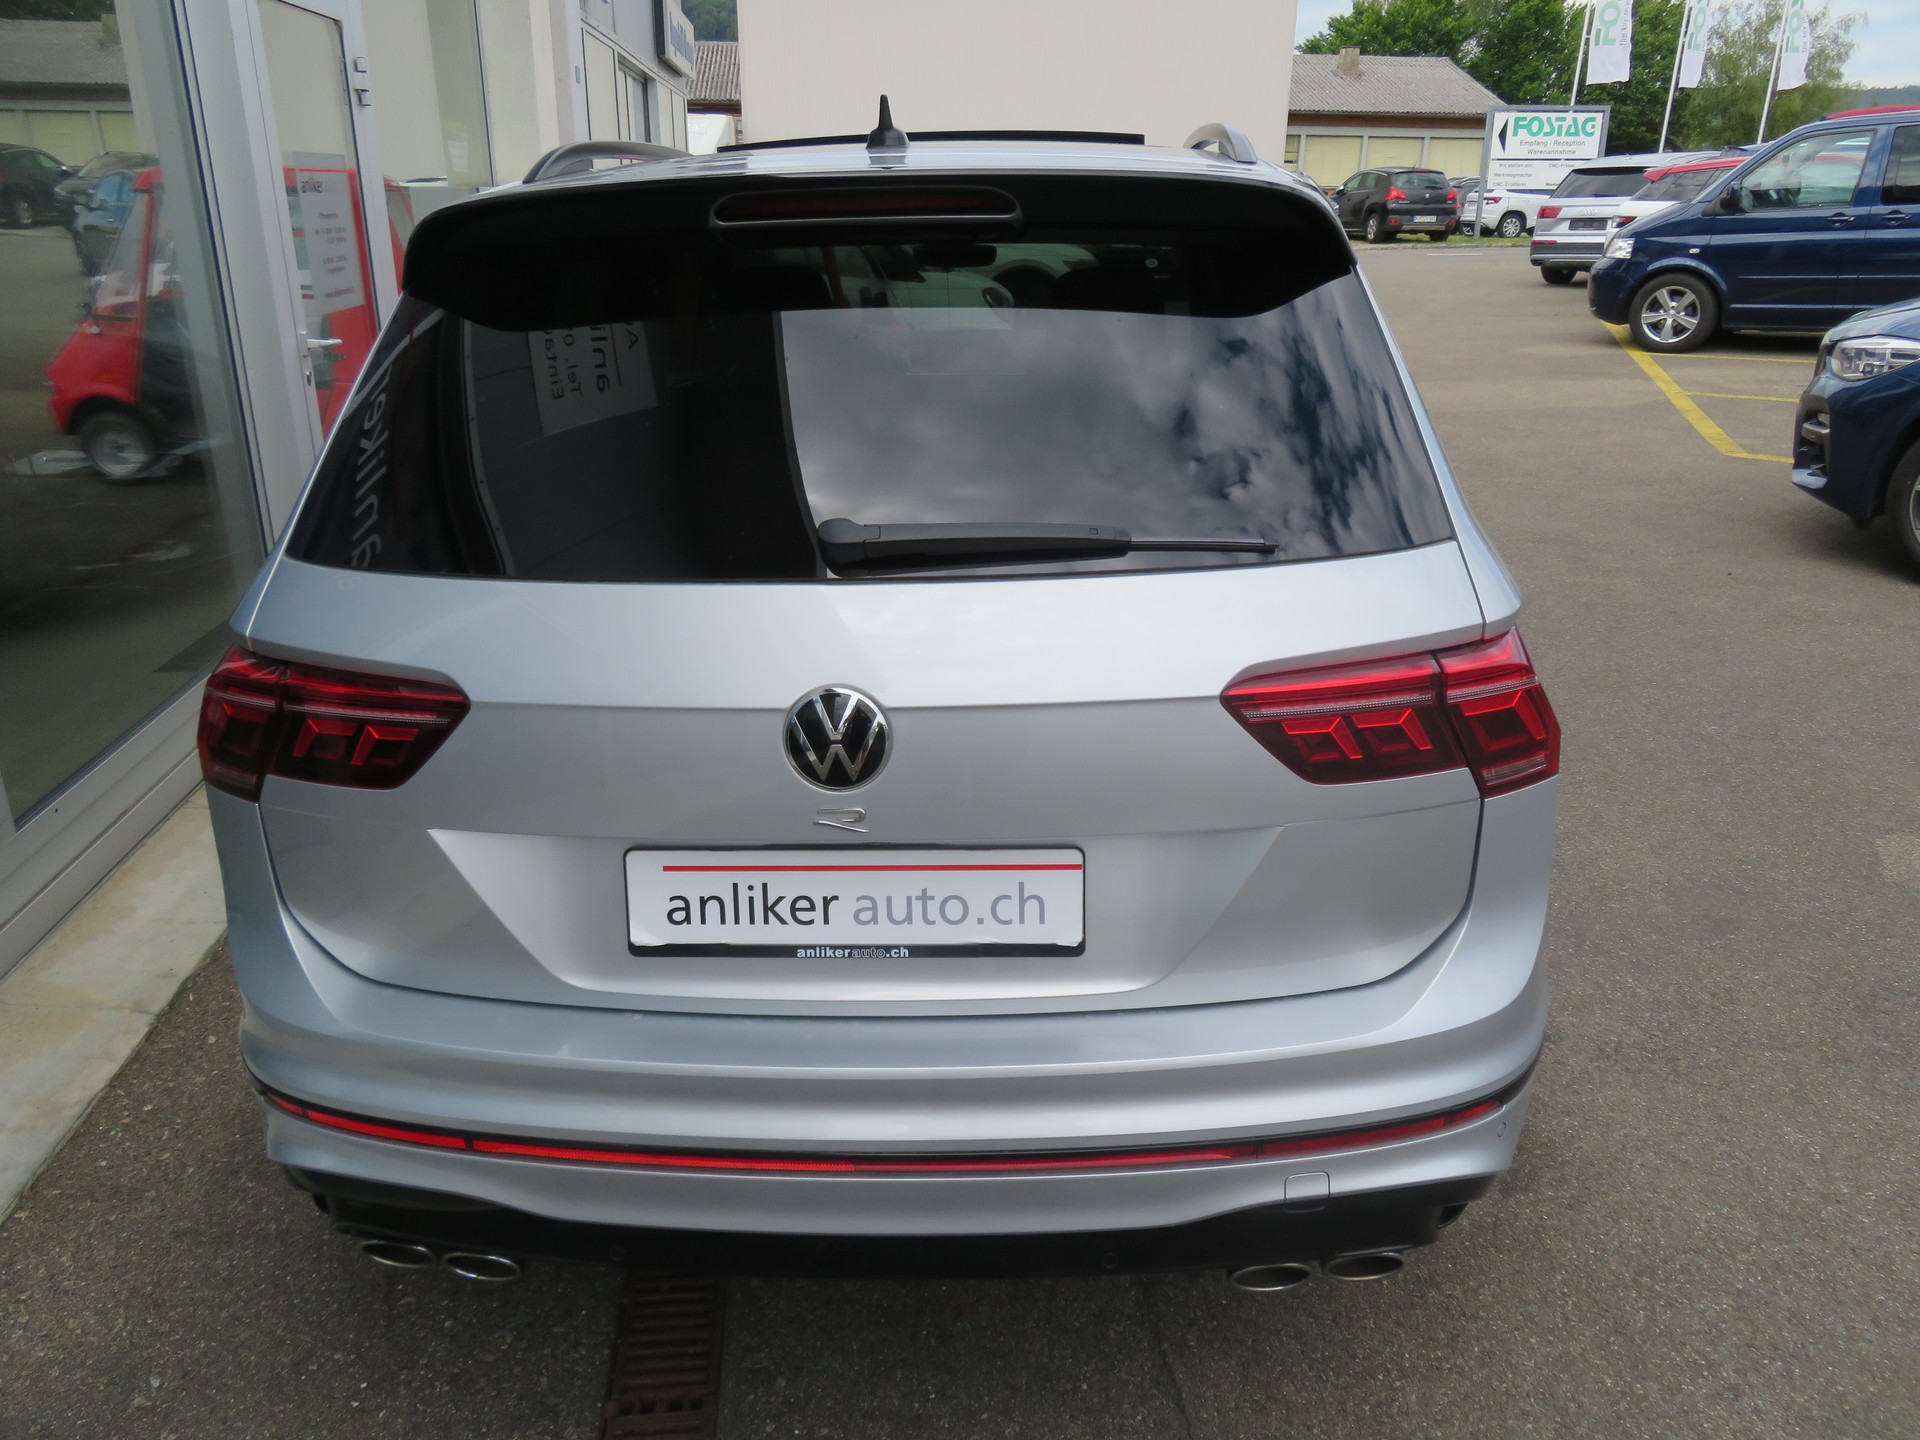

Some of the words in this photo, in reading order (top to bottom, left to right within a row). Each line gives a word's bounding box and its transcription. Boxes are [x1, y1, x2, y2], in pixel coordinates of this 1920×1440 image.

[1594, 0, 1621, 46] FO
[1512, 116, 1597, 138] FOSTAG
[1519, 139, 1548, 147] Empfang
[666, 882, 840, 926] anliker
[853, 881, 1046, 926] auto.ch
[797, 946, 909, 958] anlikerauto.ch
